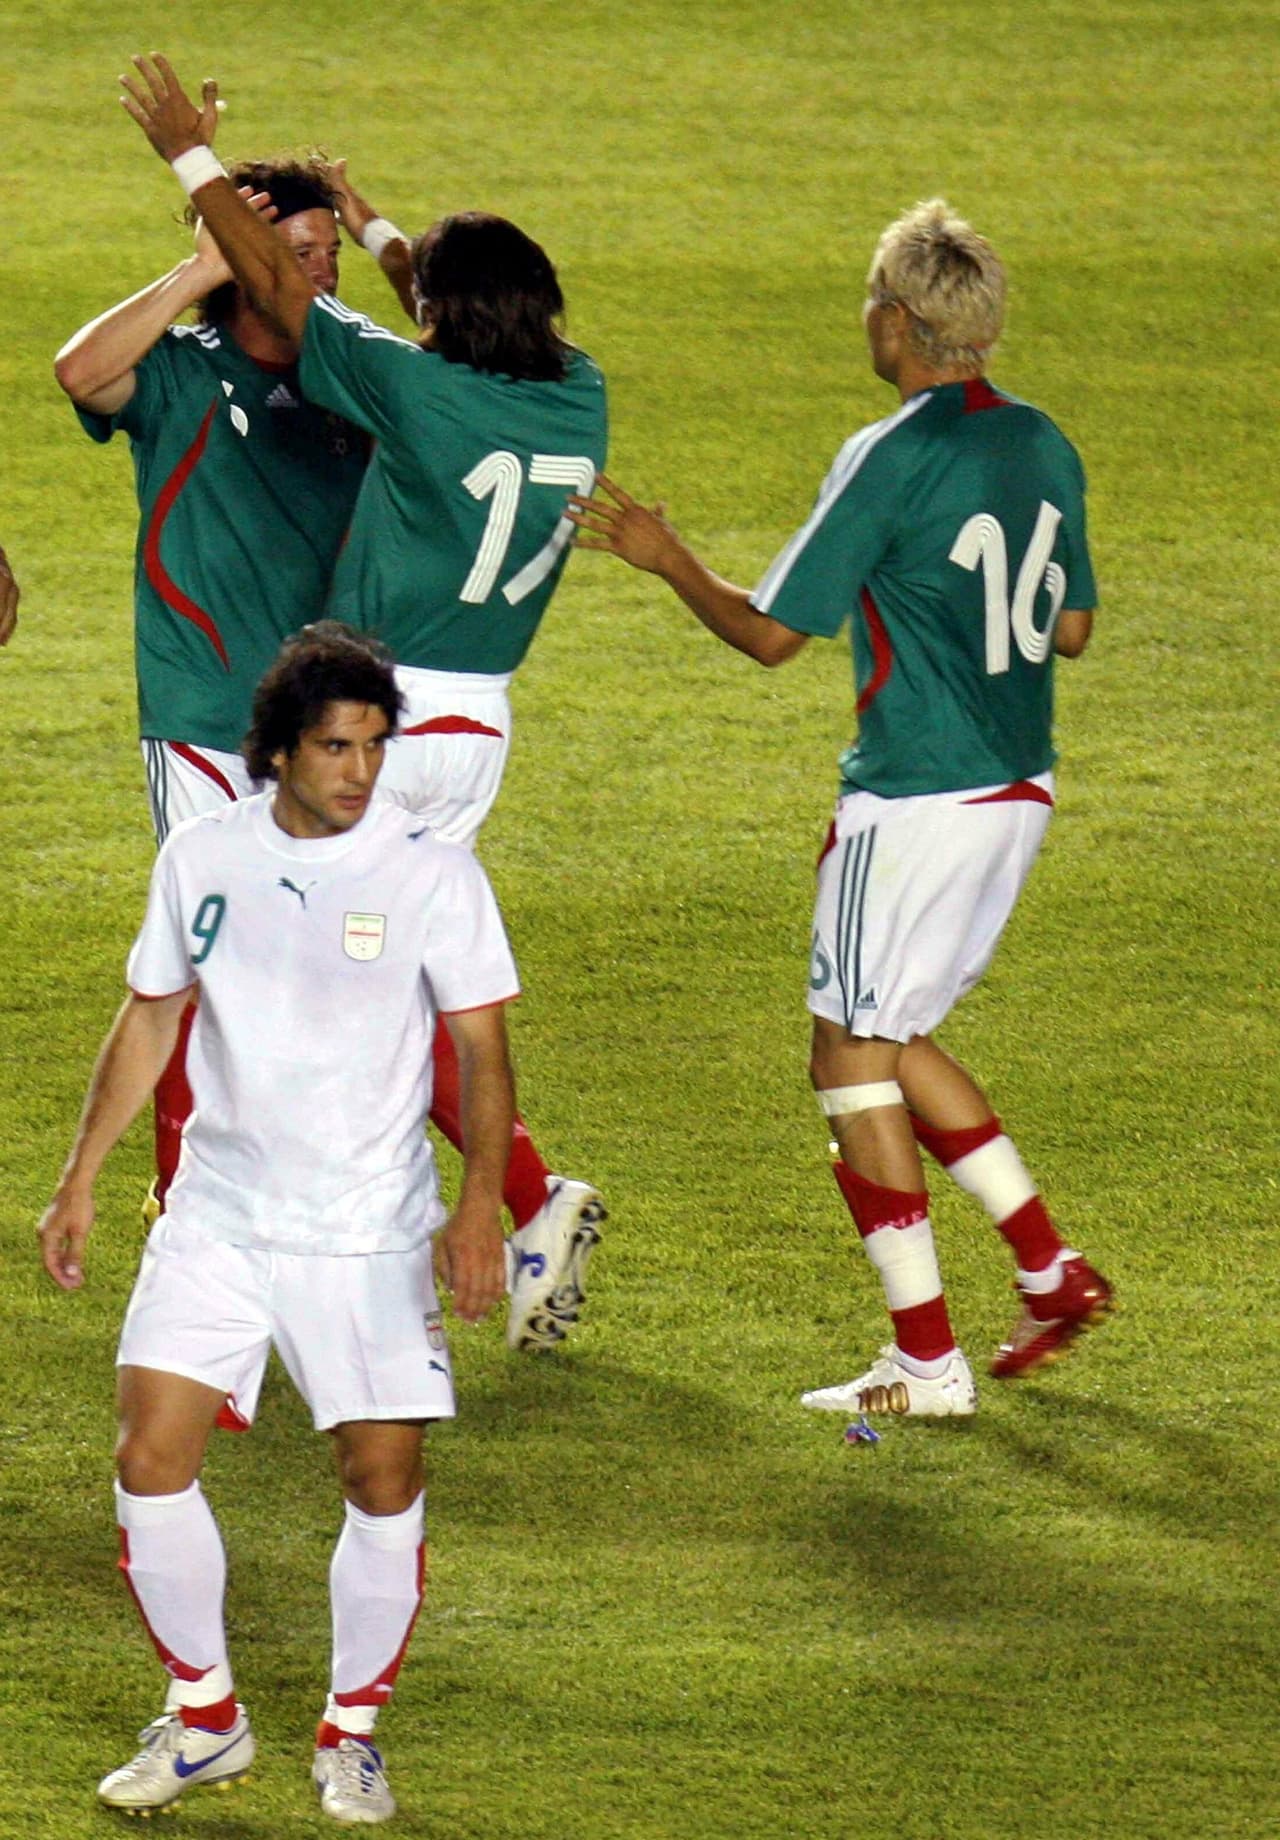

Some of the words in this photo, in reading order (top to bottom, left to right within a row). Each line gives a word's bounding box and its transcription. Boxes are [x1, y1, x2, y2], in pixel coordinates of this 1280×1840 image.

[459, 450, 596, 606] 17
[948, 499, 1067, 676] 16
[190, 893, 228, 964] 9
